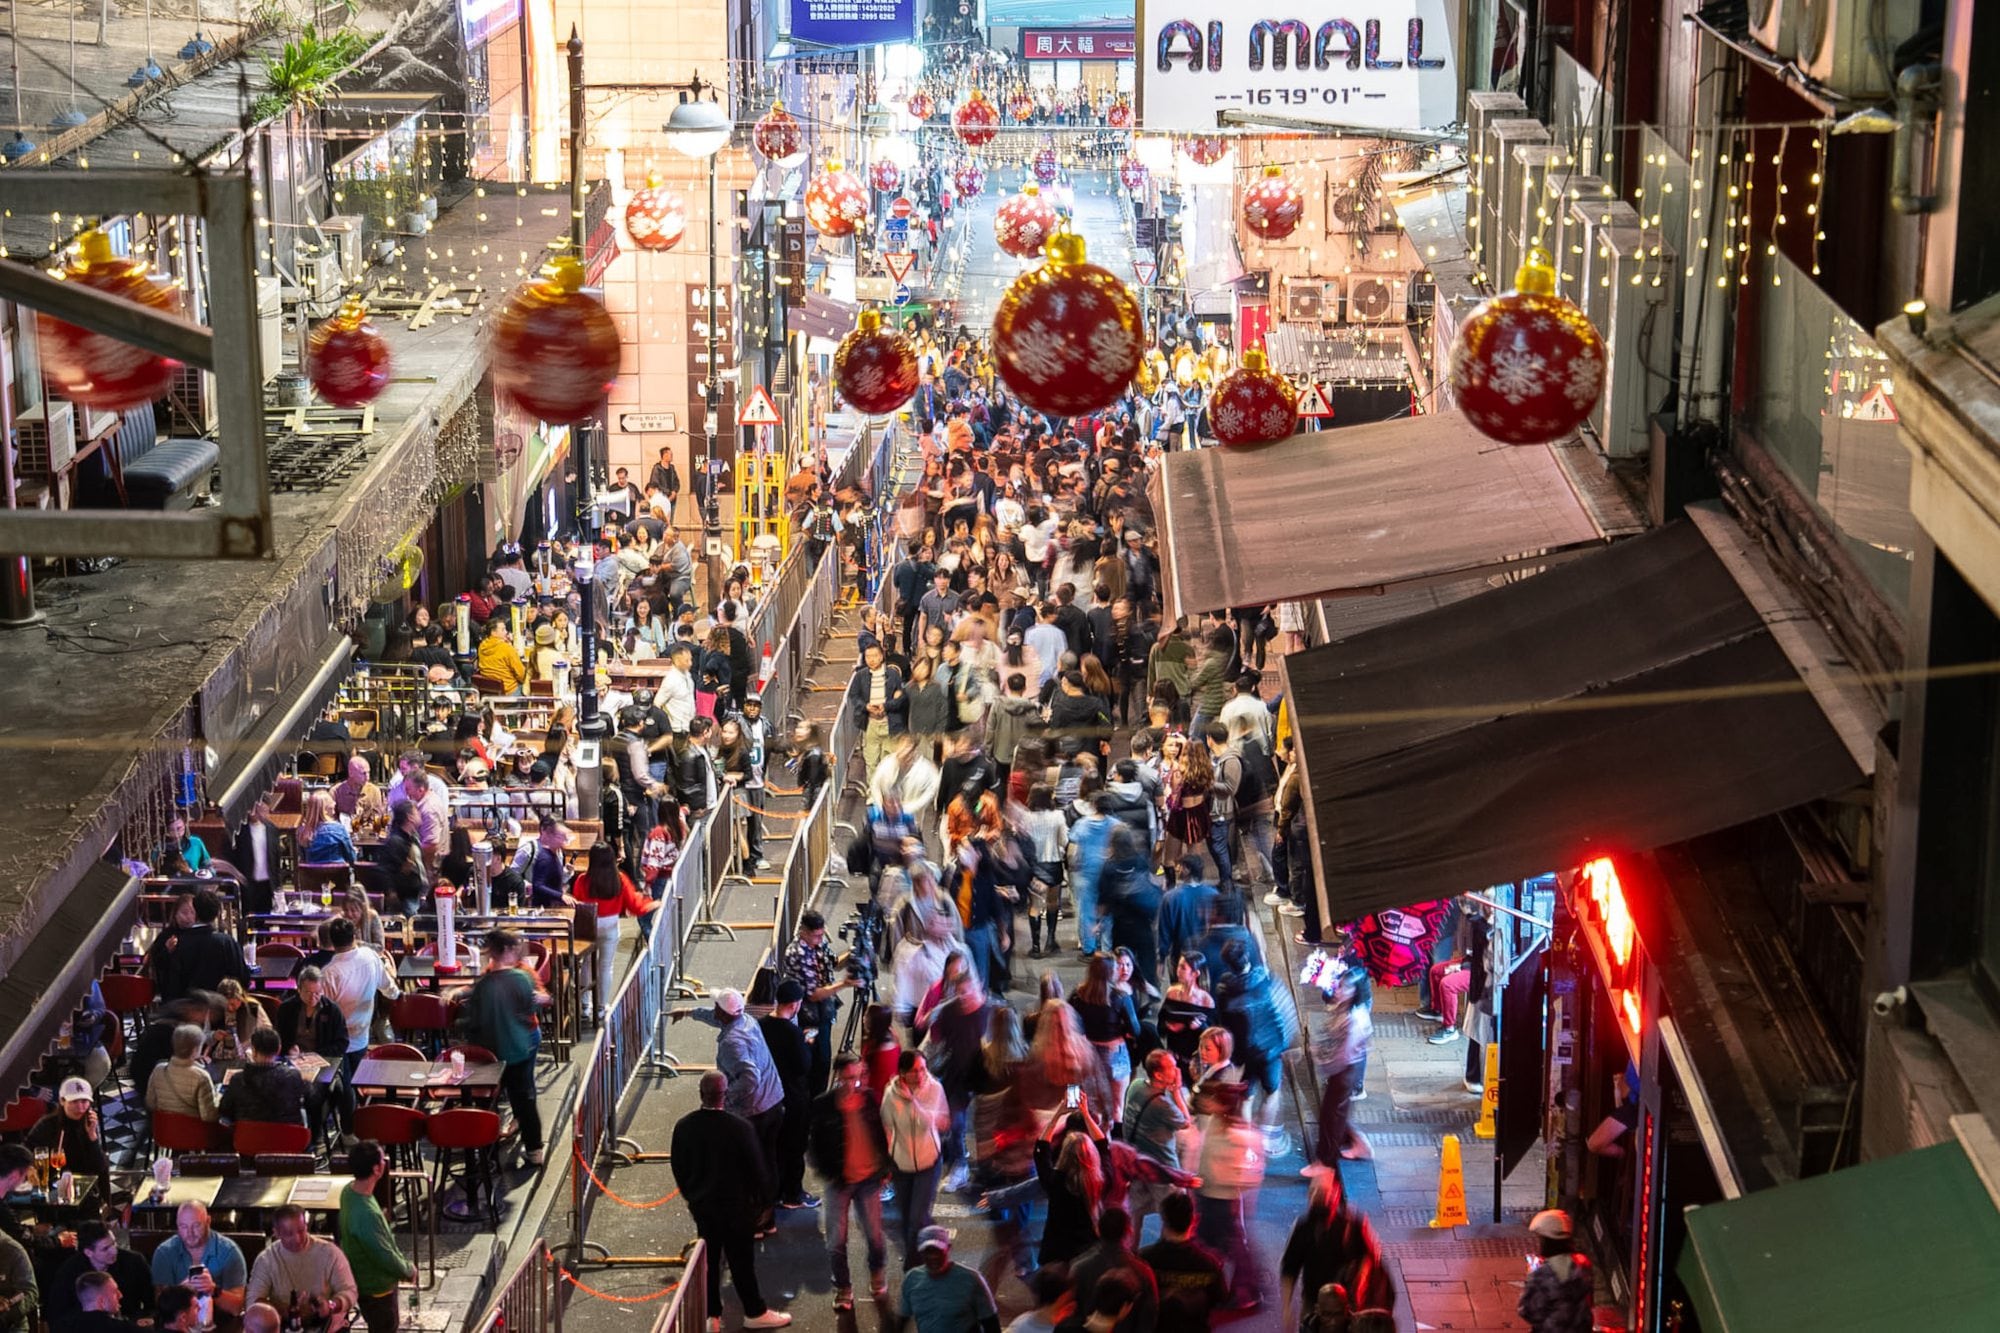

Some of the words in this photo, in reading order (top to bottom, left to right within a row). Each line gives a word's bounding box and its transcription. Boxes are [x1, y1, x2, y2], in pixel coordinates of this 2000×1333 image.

[1036, 36, 1094, 54] 周大福
[1157, 18, 1223, 72] AI
[1249, 17, 1446, 72] MALL
